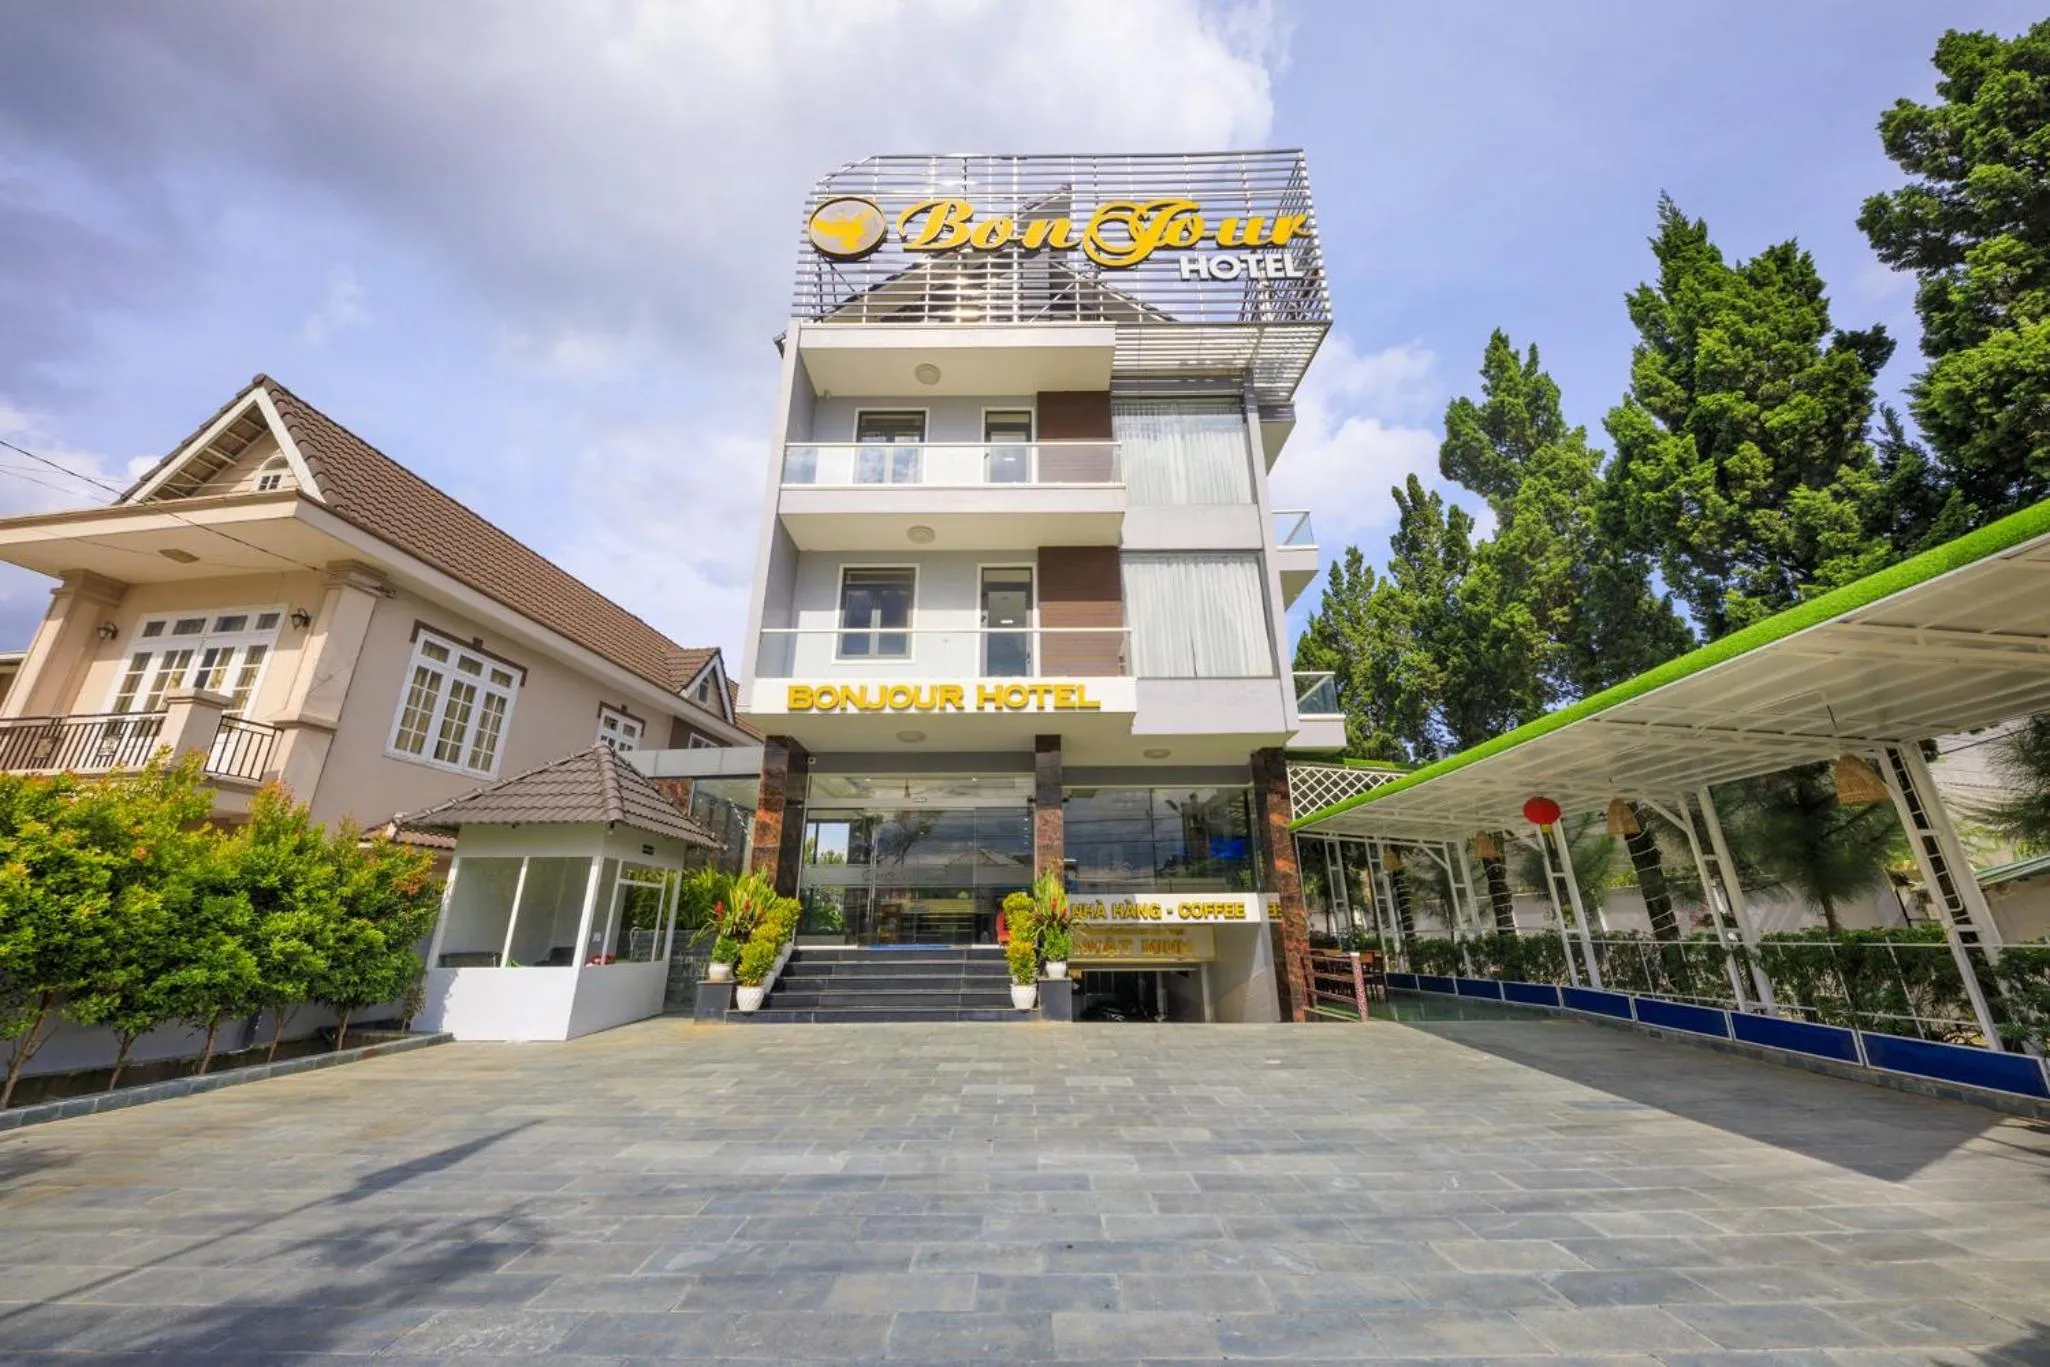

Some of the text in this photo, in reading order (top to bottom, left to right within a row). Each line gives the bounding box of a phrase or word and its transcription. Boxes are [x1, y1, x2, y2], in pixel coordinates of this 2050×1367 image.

[1179, 254, 1304, 280] HOTEL
[787, 683, 1101, 711] BONJOUR HOTEL
[1071, 899, 1106, 920] NHÀ
[1111, 899, 1162, 920] HÀNG
[1178, 902, 1246, 920] COFFEE
